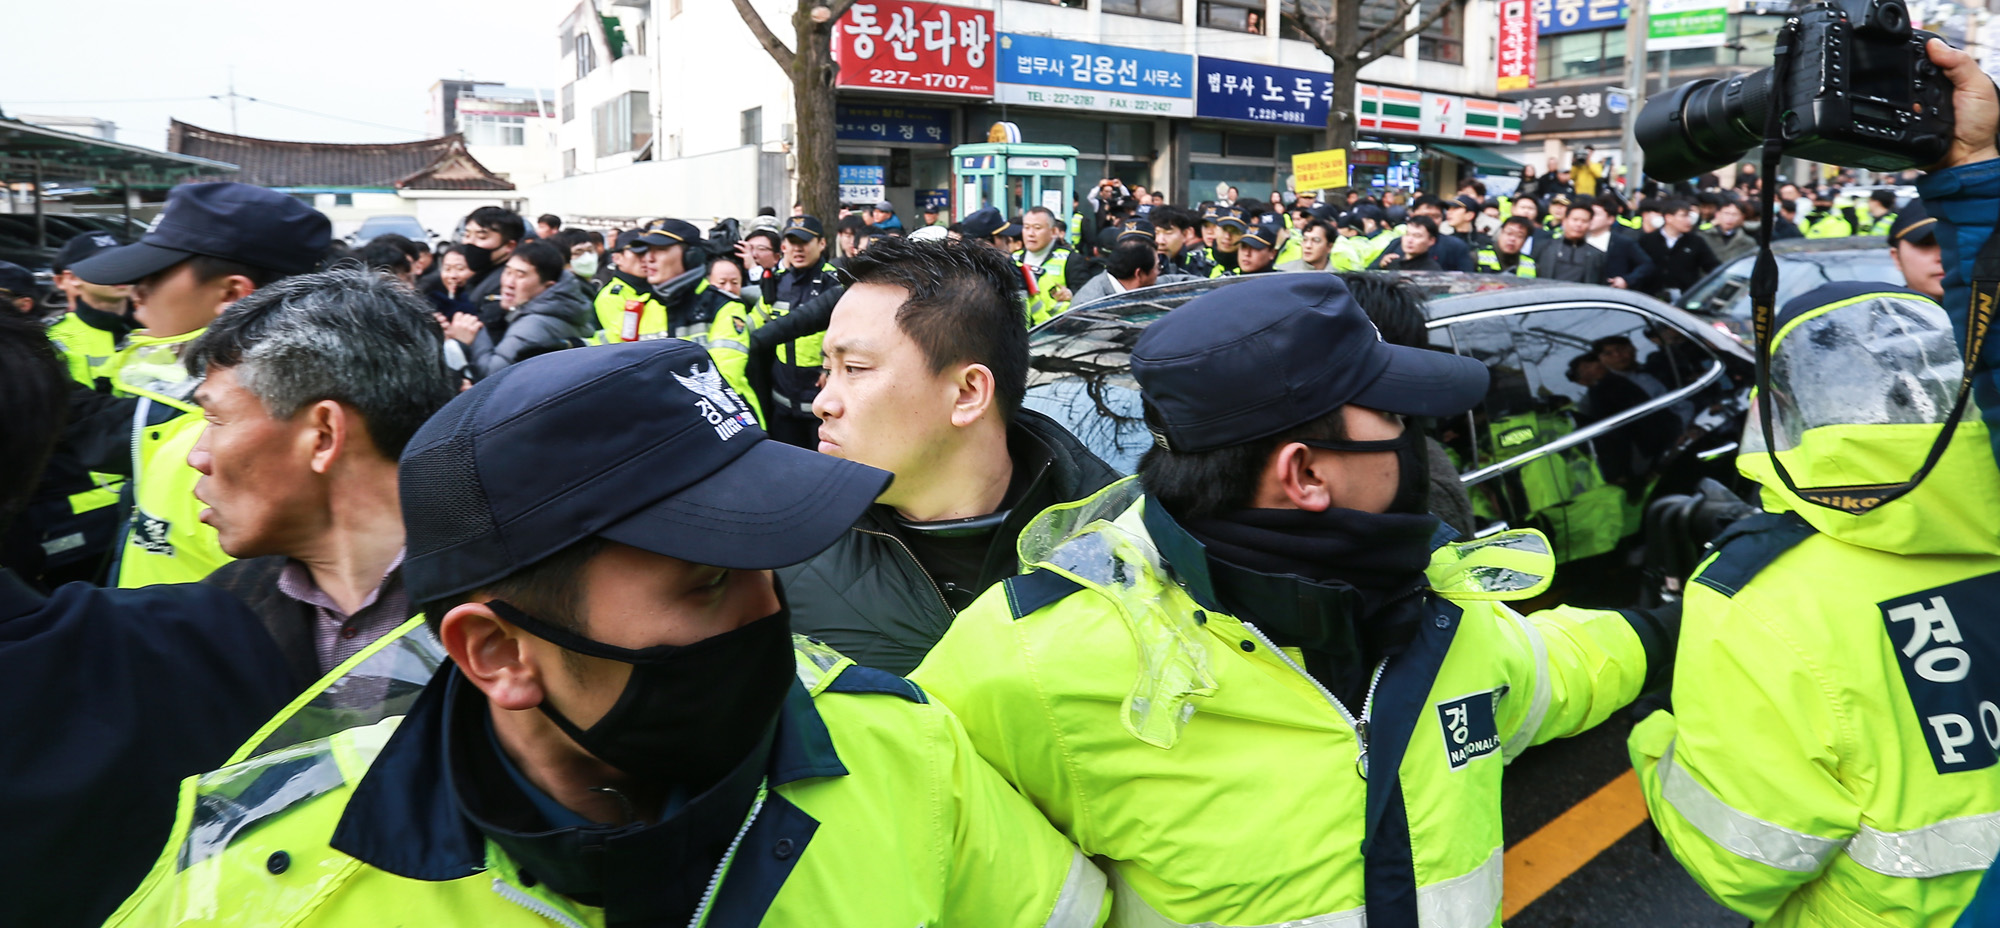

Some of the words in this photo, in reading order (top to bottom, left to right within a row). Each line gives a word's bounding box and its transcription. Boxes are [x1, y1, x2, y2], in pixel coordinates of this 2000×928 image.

[844, 3, 991, 68] 동산다방
[869, 69, 970, 89] 227-1707
[1017, 55, 1065, 77] 법무사
[1070, 54, 1137, 87] 김용선
[1142, 69, 1182, 88] 사무소
[1207, 72, 1255, 97] 법무사
[1027, 91, 1044, 102] TEL
[1109, 99, 1127, 109] FAX
[694, 397, 723, 425] 경
[1808, 496, 1887, 509] Niko
[1888, 595, 1971, 683] 경
[1444, 703, 1469, 744] 경
[1927, 700, 2000, 765] PO
[1450, 737, 1494, 763] NAONAL
